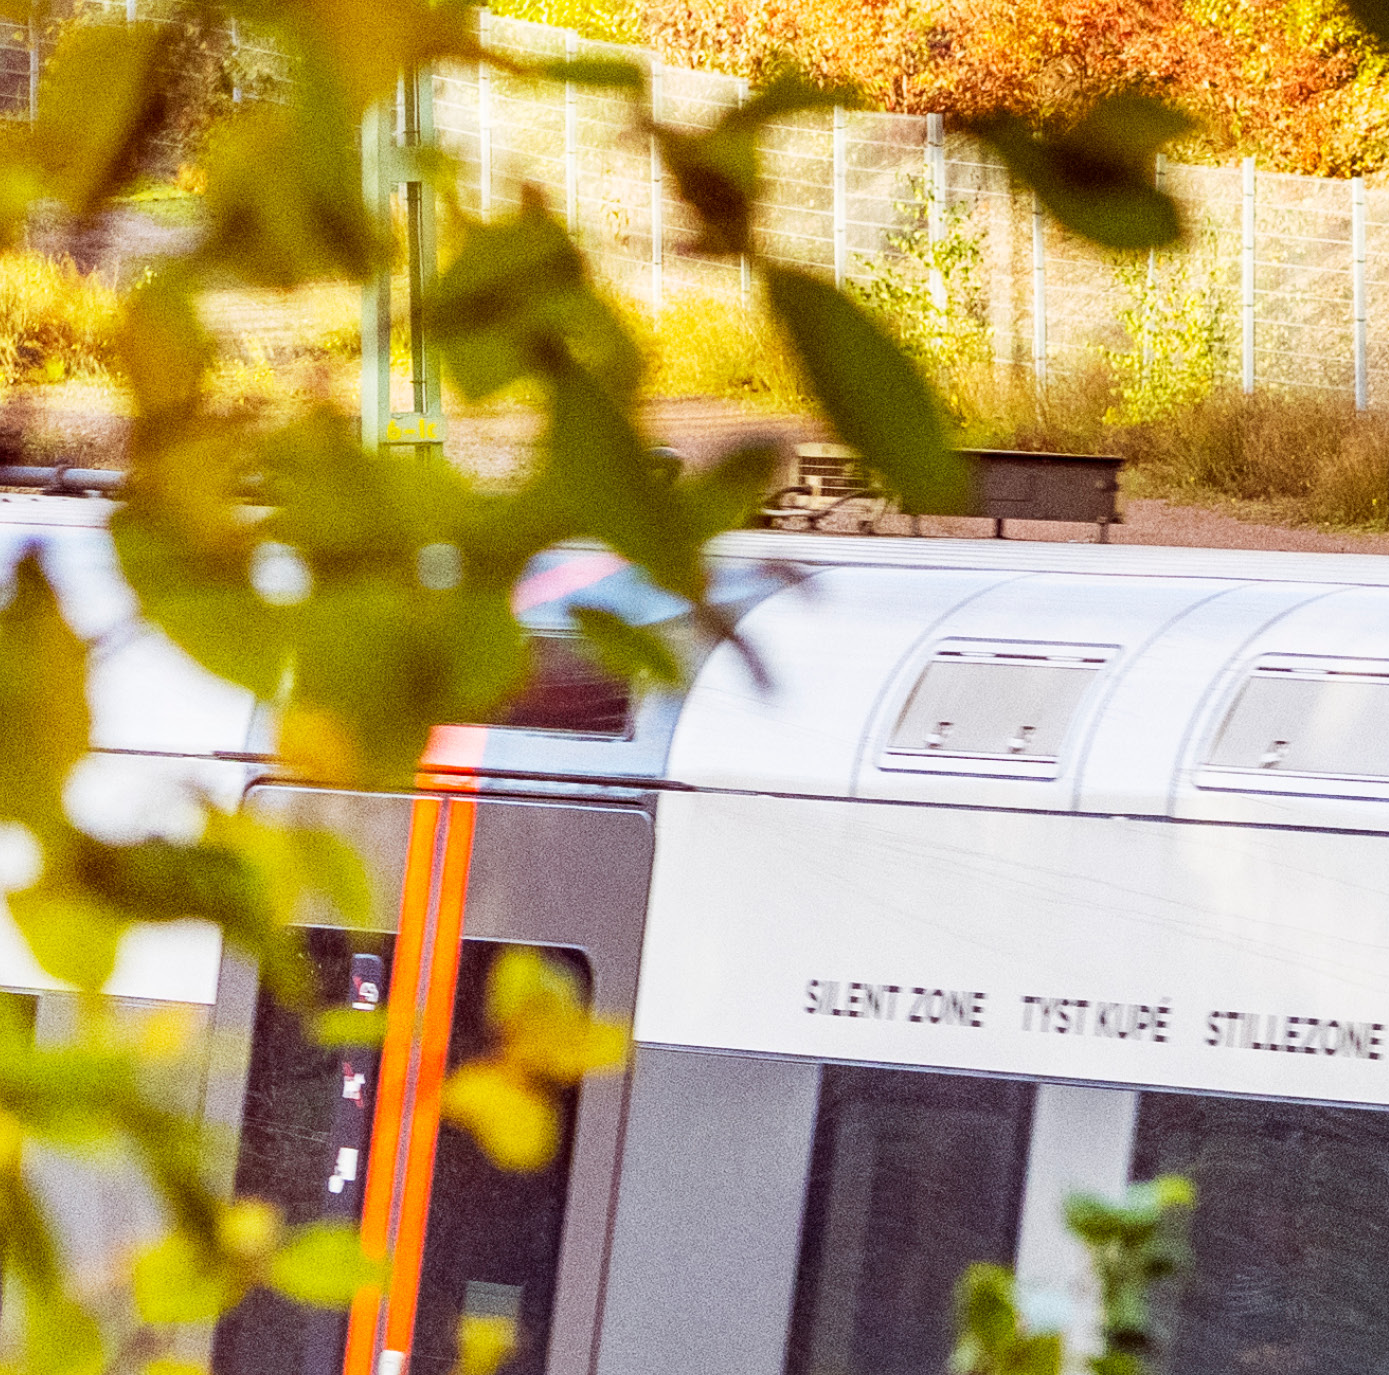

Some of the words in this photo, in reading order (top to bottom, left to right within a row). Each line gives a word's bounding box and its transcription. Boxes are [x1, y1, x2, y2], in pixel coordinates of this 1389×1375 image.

[803, 980, 901, 1020] SILENT
[907, 986, 988, 1028] ZONE
[1020, 995, 1091, 1034] TYST
[1094, 996, 1173, 1043] KUPÉ
[1205, 1011, 1386, 1060] STILLEZONE
